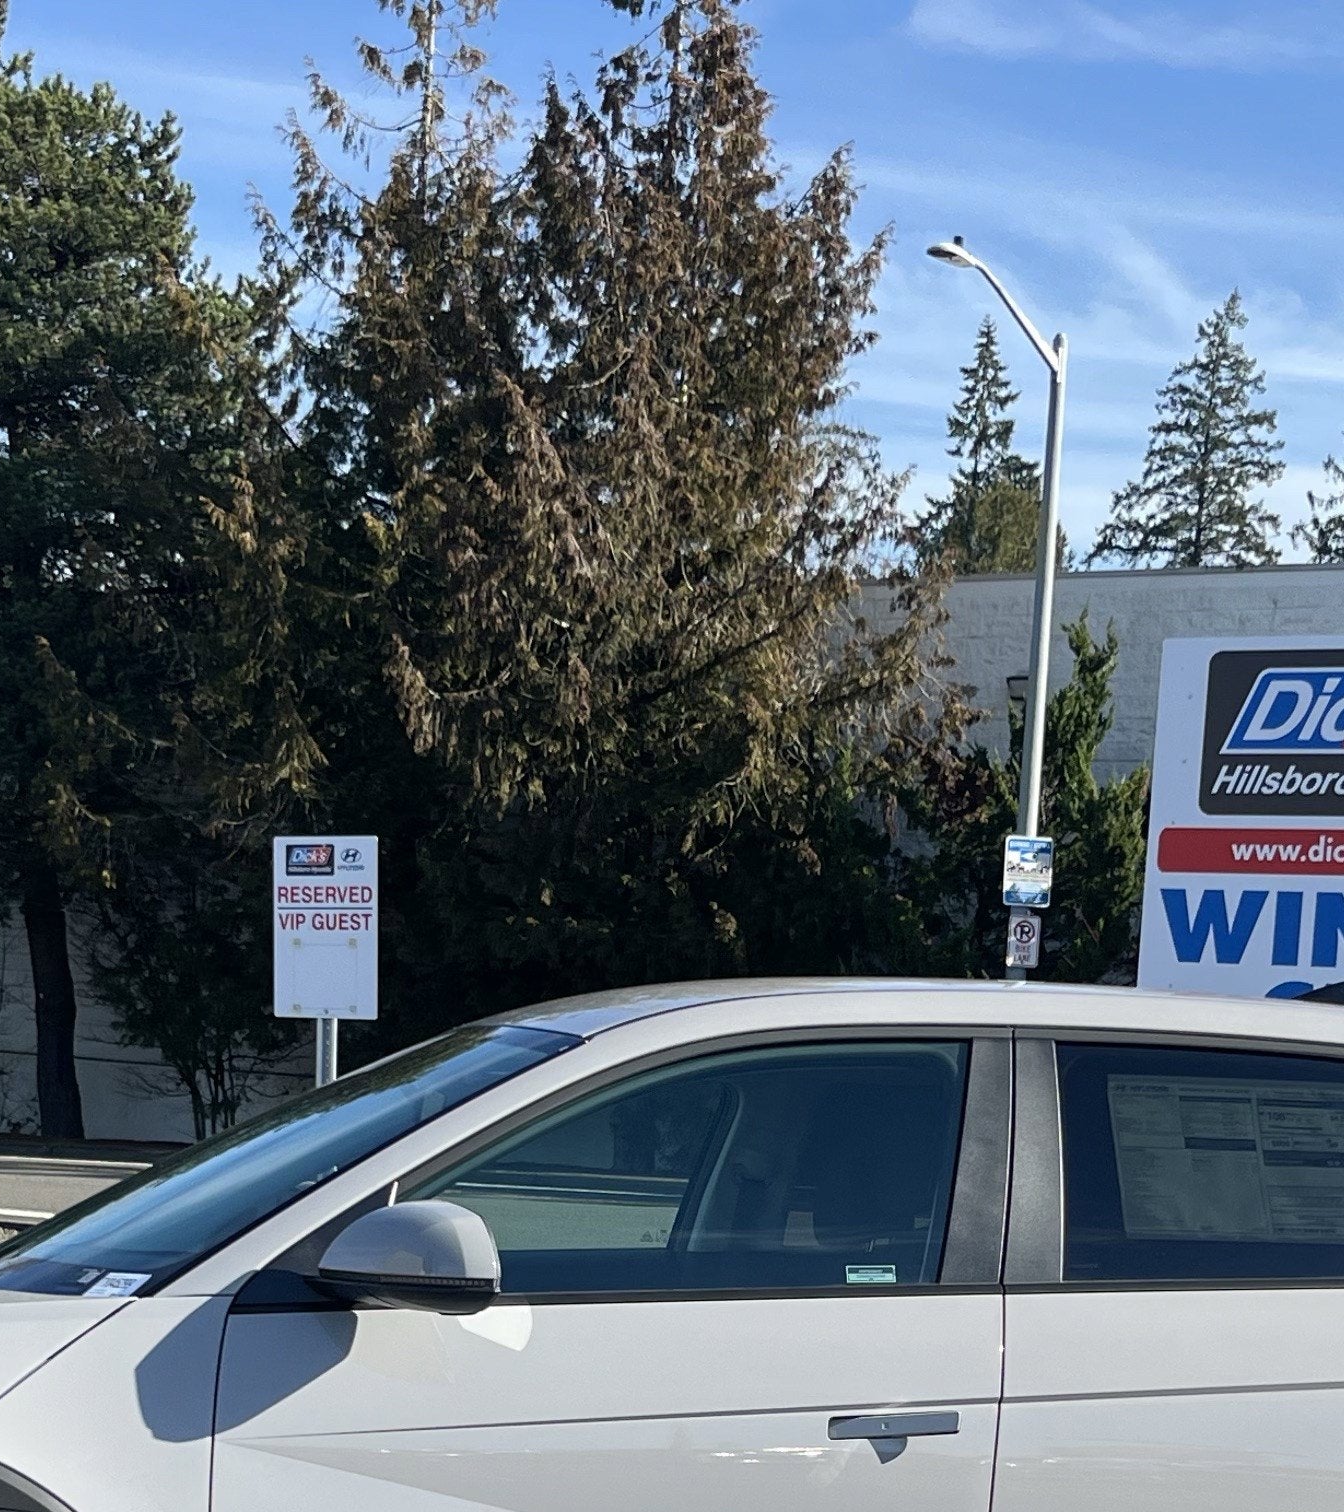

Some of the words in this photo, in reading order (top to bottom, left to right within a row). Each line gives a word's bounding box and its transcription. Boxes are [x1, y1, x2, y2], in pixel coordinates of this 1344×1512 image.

[277, 886, 373, 904] RESERVED
[278, 913, 306, 930] VIP
[311, 912, 373, 931] GUEST
